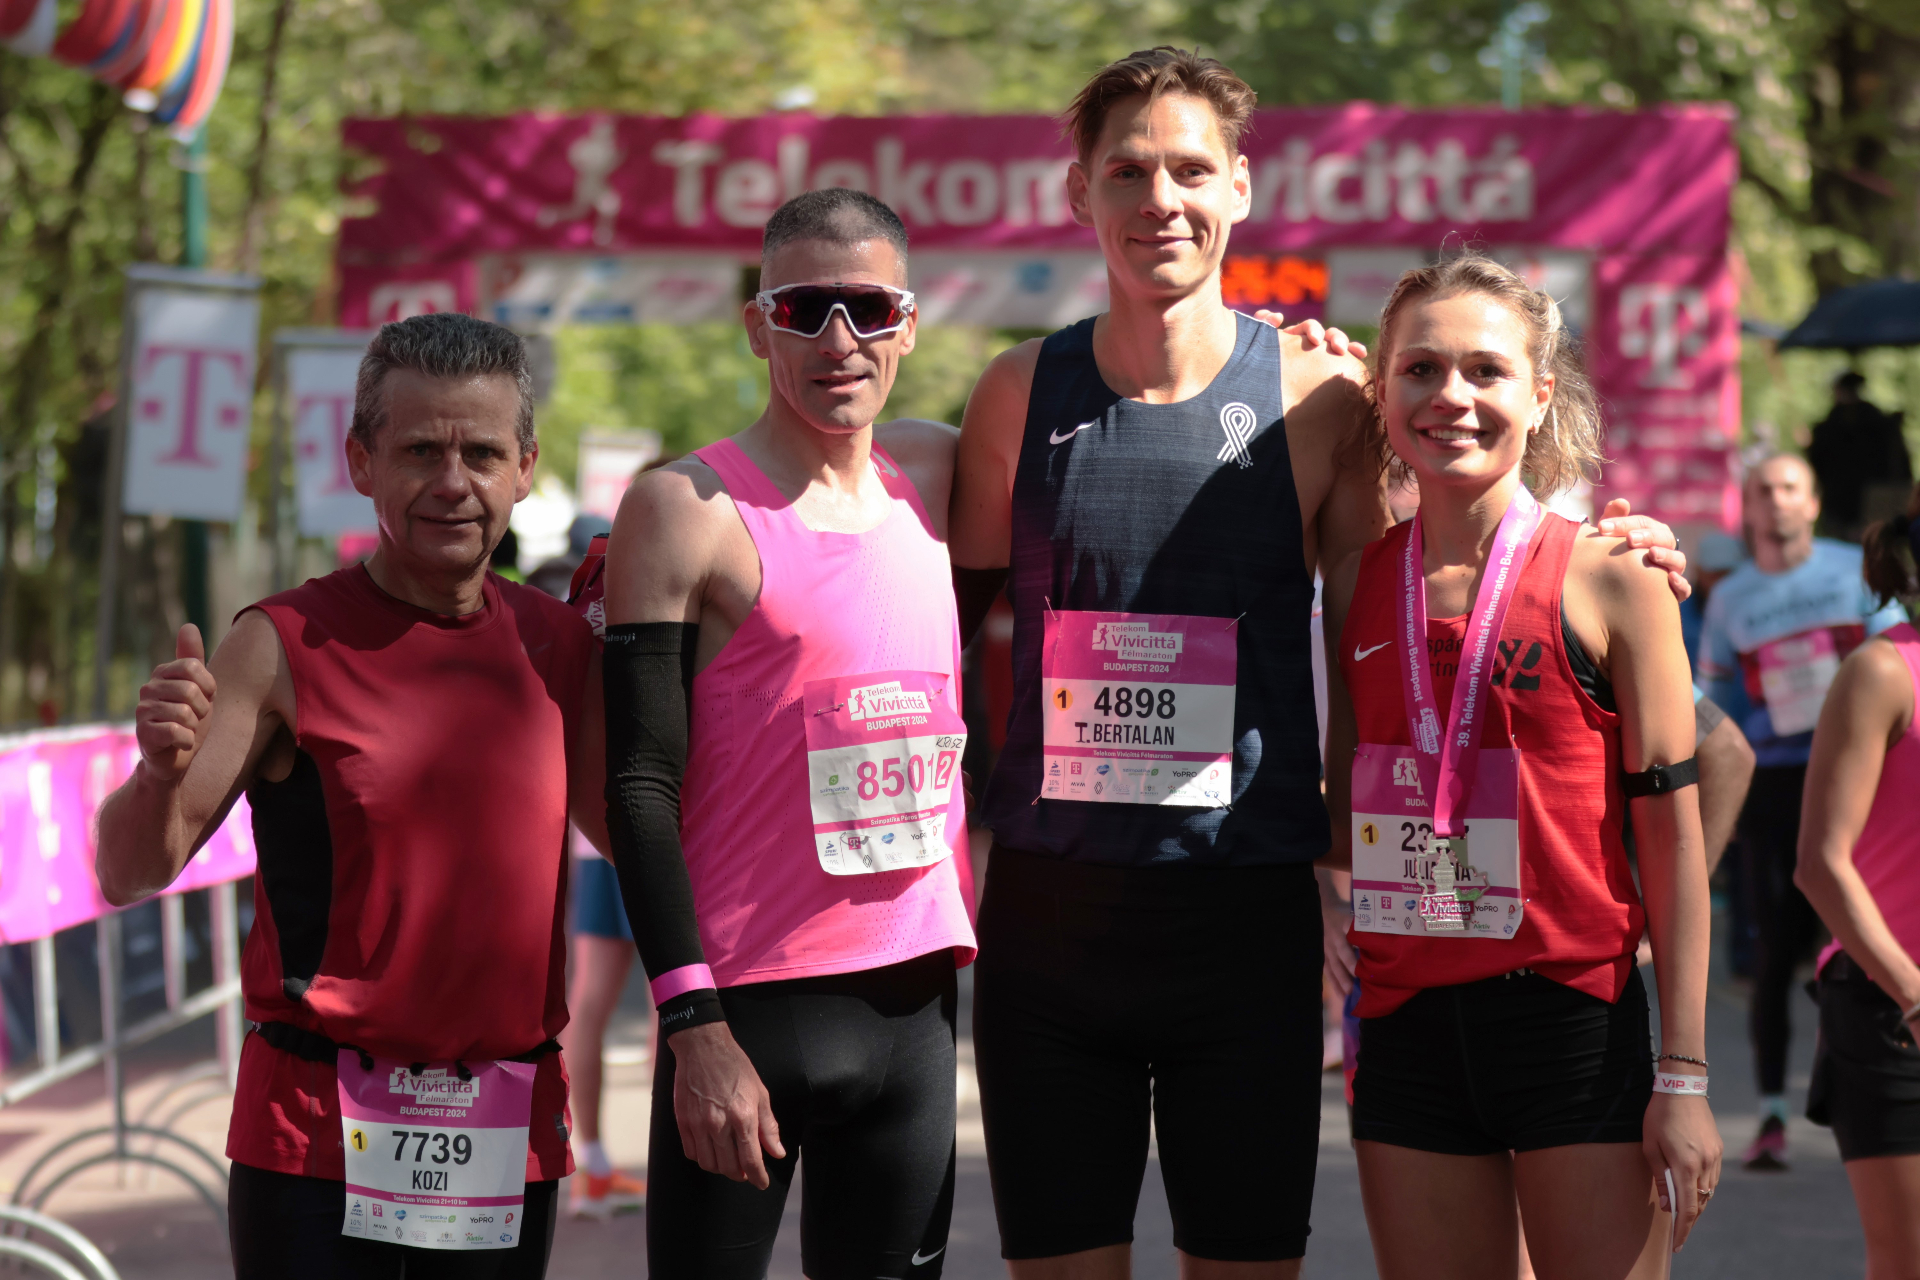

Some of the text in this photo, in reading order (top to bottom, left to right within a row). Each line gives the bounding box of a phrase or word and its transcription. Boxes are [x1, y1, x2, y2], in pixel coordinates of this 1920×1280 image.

[651, 134, 1535, 227] Telekom vicittá
[1404, 542, 1416, 585] Vivicittá
[1481, 567, 1510, 627] Félmaraton
[1405, 586, 1419, 646] Félmaraton
[1111, 625, 1146, 633] Telekom
[605, 632, 636, 645] alenji
[1111, 634, 1176, 649] Vivicittá
[1121, 650, 1173, 660] Félmaraton
[1469, 626, 1490, 674] Vivicittá
[1103, 662, 1170, 673] BUDAPEST 2024
[1408, 646, 1424, 702] Budapest
[866, 685, 901, 697] Telekom
[1057, 690, 1067, 709] 1
[869, 694, 926, 713] Vivicittá
[1093, 686, 1176, 719] 4898
[1461, 676, 1479, 725] Telekom
[866, 715, 928, 731] BUDAPEST 2024
[1424, 718, 1436, 751] Vivicittá
[1456, 726, 1472, 748] 39.
[1172, 770, 1197, 778] YoPRO
[1364, 825, 1374, 843] 1
[1432, 902, 1471, 913] Vivicittá
[1475, 905, 1498, 913] YoPRO
[1662, 1079, 1686, 1089] VIP
[420, 1095, 470, 1104] Félmaraton
[400, 1106, 466, 1118] BUDAPEST 2024
[353, 1131, 363, 1150] 1
[392, 1130, 472, 1165] 7739
[412, 1170, 448, 1191] KOZI
[393, 1195, 415, 1204] Telekom
[416, 1196, 440, 1205] Vivicittá
[470, 1216, 494, 1224] YoPRO
